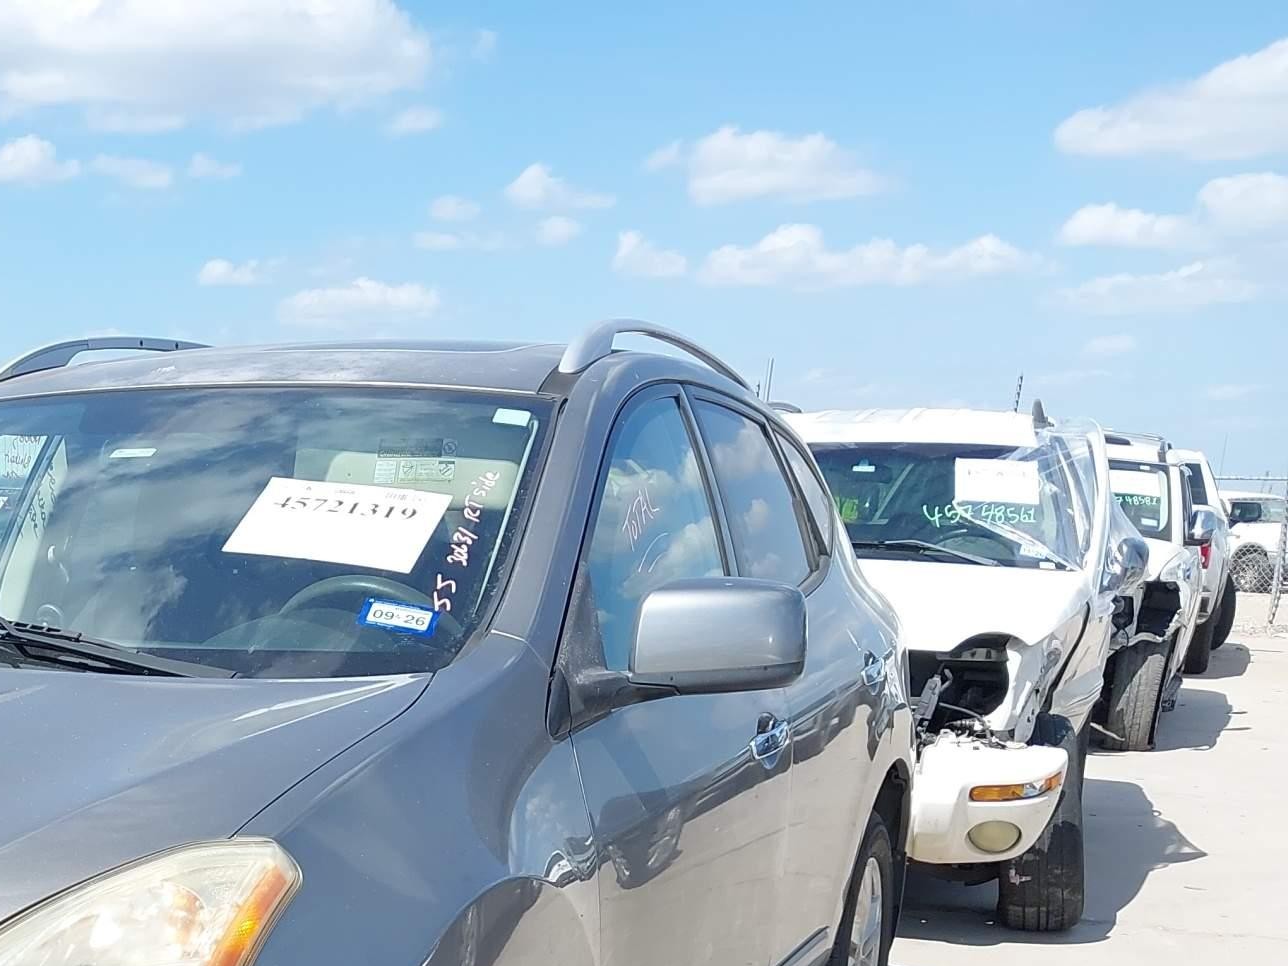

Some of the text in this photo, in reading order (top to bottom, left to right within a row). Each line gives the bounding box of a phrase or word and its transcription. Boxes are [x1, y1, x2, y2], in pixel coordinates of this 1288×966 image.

[470, 470, 501, 497] side
[272, 496, 419, 520] 45721319
[463, 494, 484, 523] RT
[372, 609, 395, 620] 09
[403, 614, 427, 626] 26
